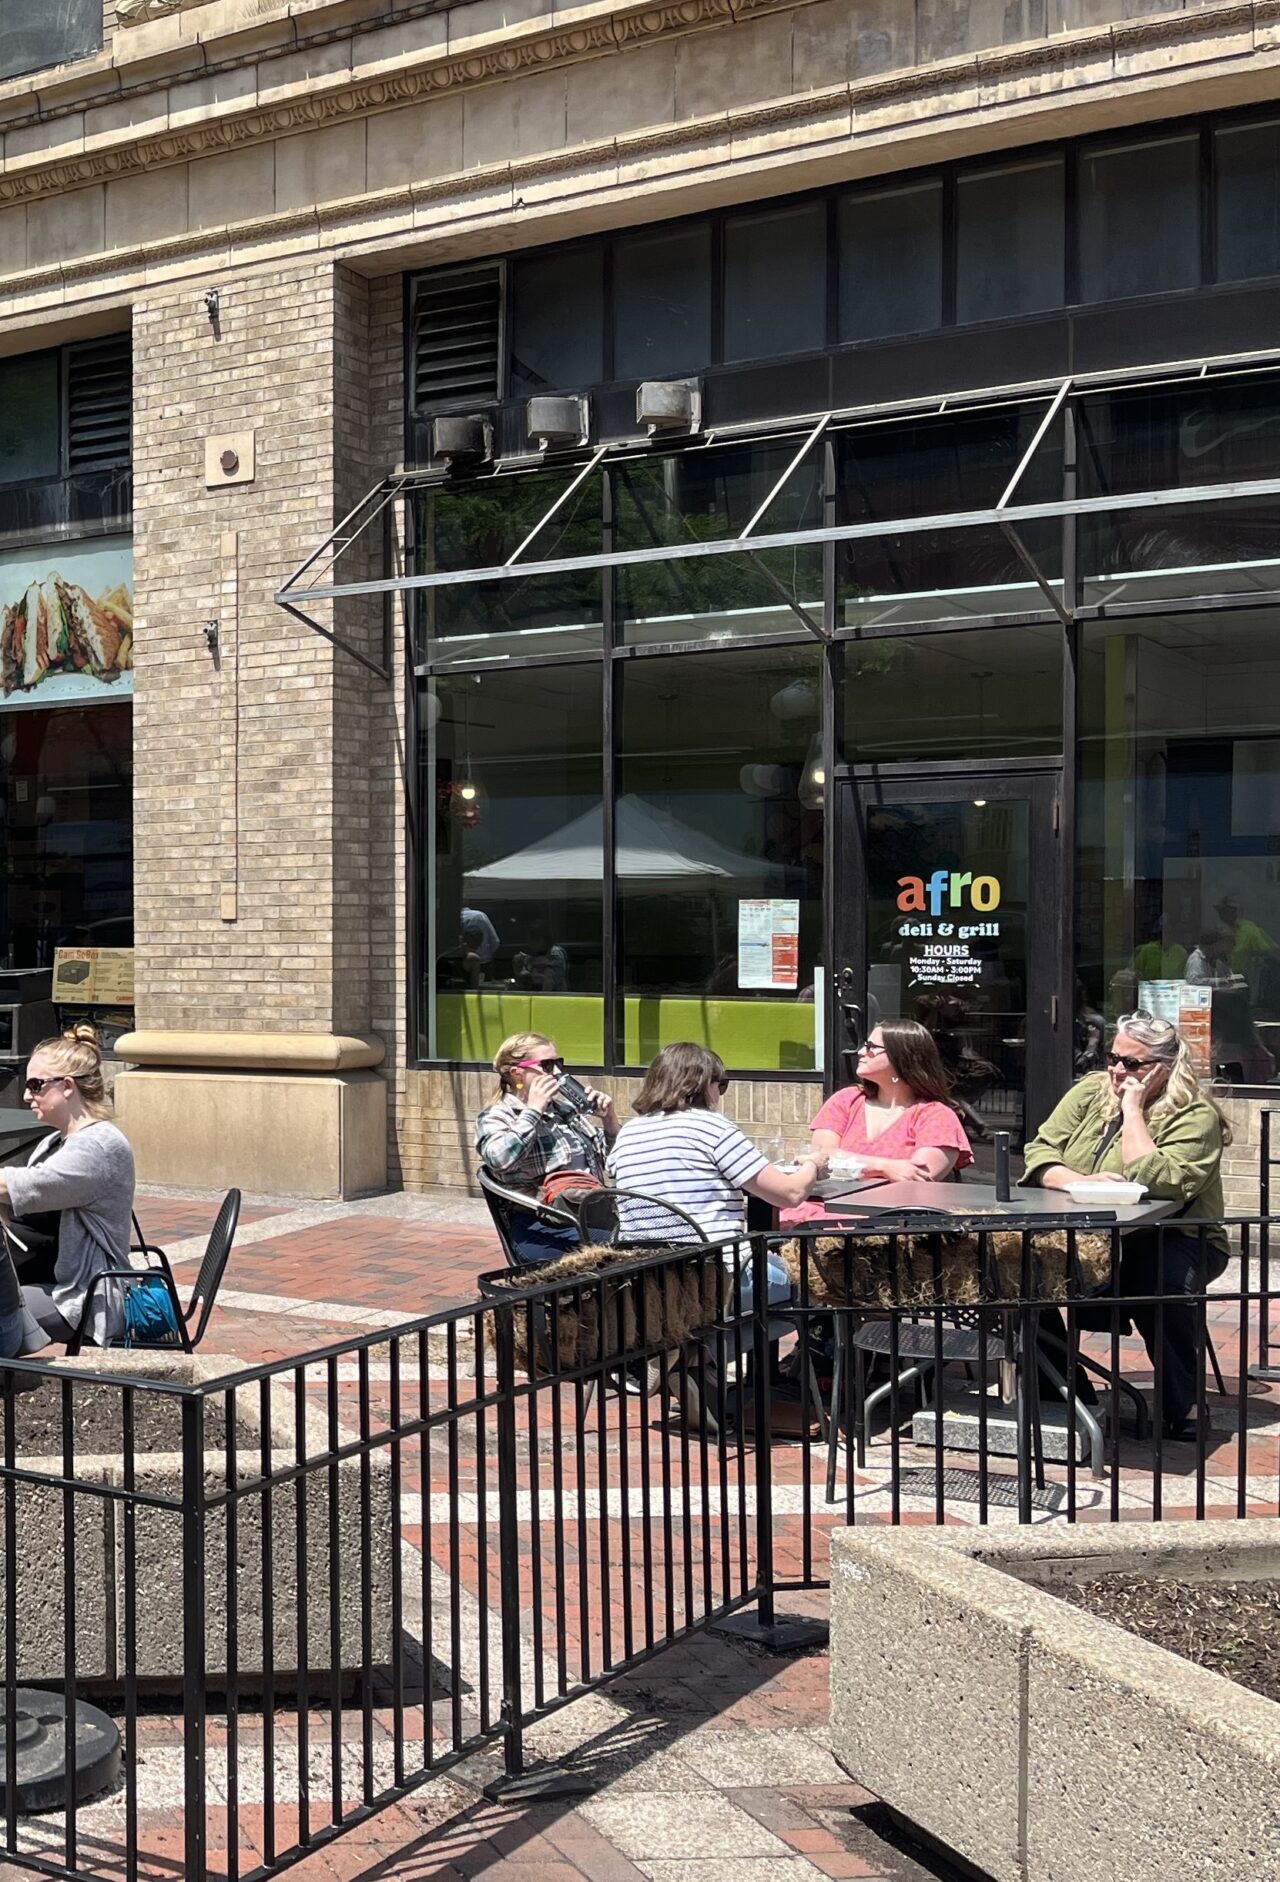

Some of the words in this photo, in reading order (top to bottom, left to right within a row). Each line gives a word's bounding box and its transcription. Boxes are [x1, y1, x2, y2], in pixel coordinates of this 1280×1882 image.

[896, 870, 1001, 917] afro
[898, 923, 933, 937] deli
[937, 923, 954, 937] &
[958, 922, 1000, 940] grill
[923, 944, 970, 957] HOURS
[909, 957, 940, 967] Monday
[946, 957, 982, 967] Saturday
[910, 966, 944, 974] 10:30AM
[950, 966, 982, 974] 3:00PM
[917, 974, 946, 982] Sunday
[947, 974, 974, 982] Closed
